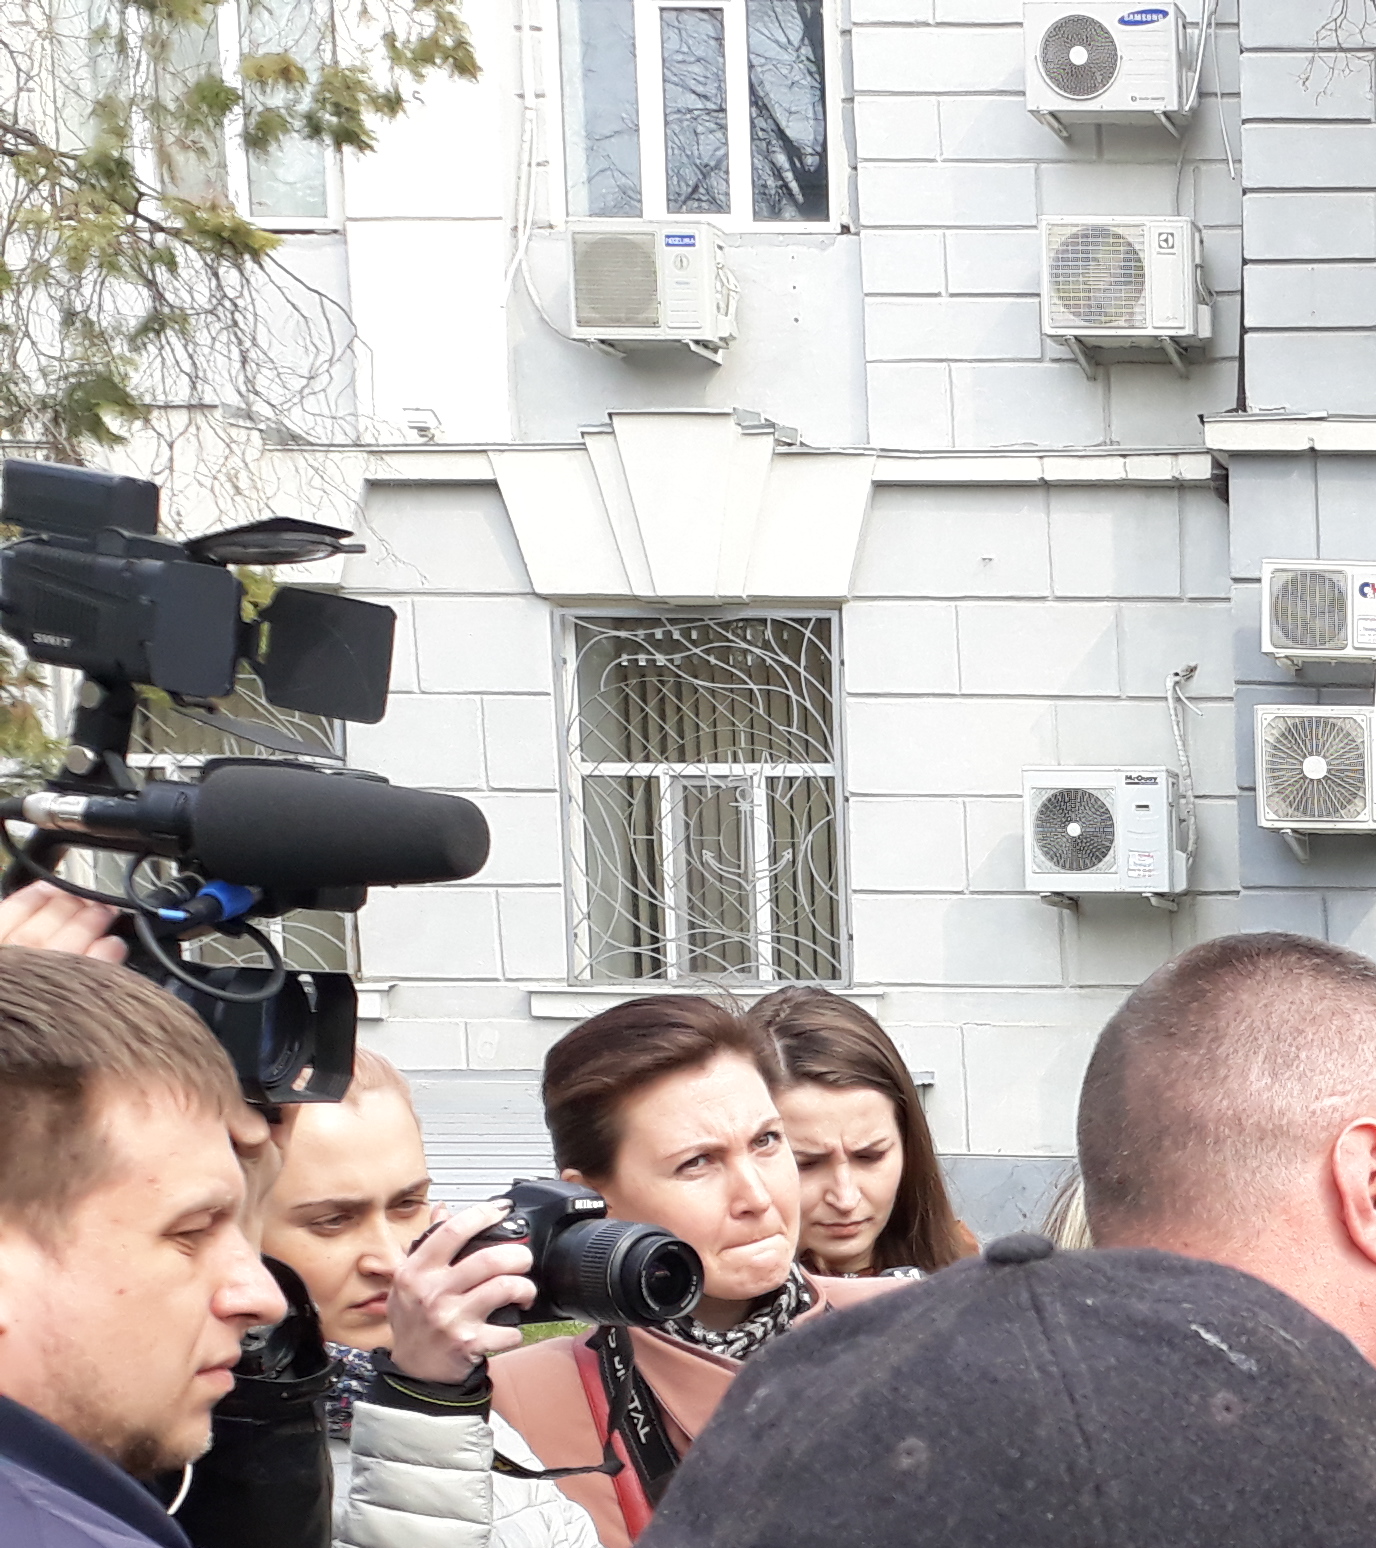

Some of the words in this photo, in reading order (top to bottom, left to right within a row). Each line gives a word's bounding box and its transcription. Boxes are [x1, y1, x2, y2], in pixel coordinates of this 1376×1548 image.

[1123, 13, 1164, 22] SAMSUNG
[574, 1199, 605, 1209] Nikon
[628, 1390, 650, 1444] TAL
